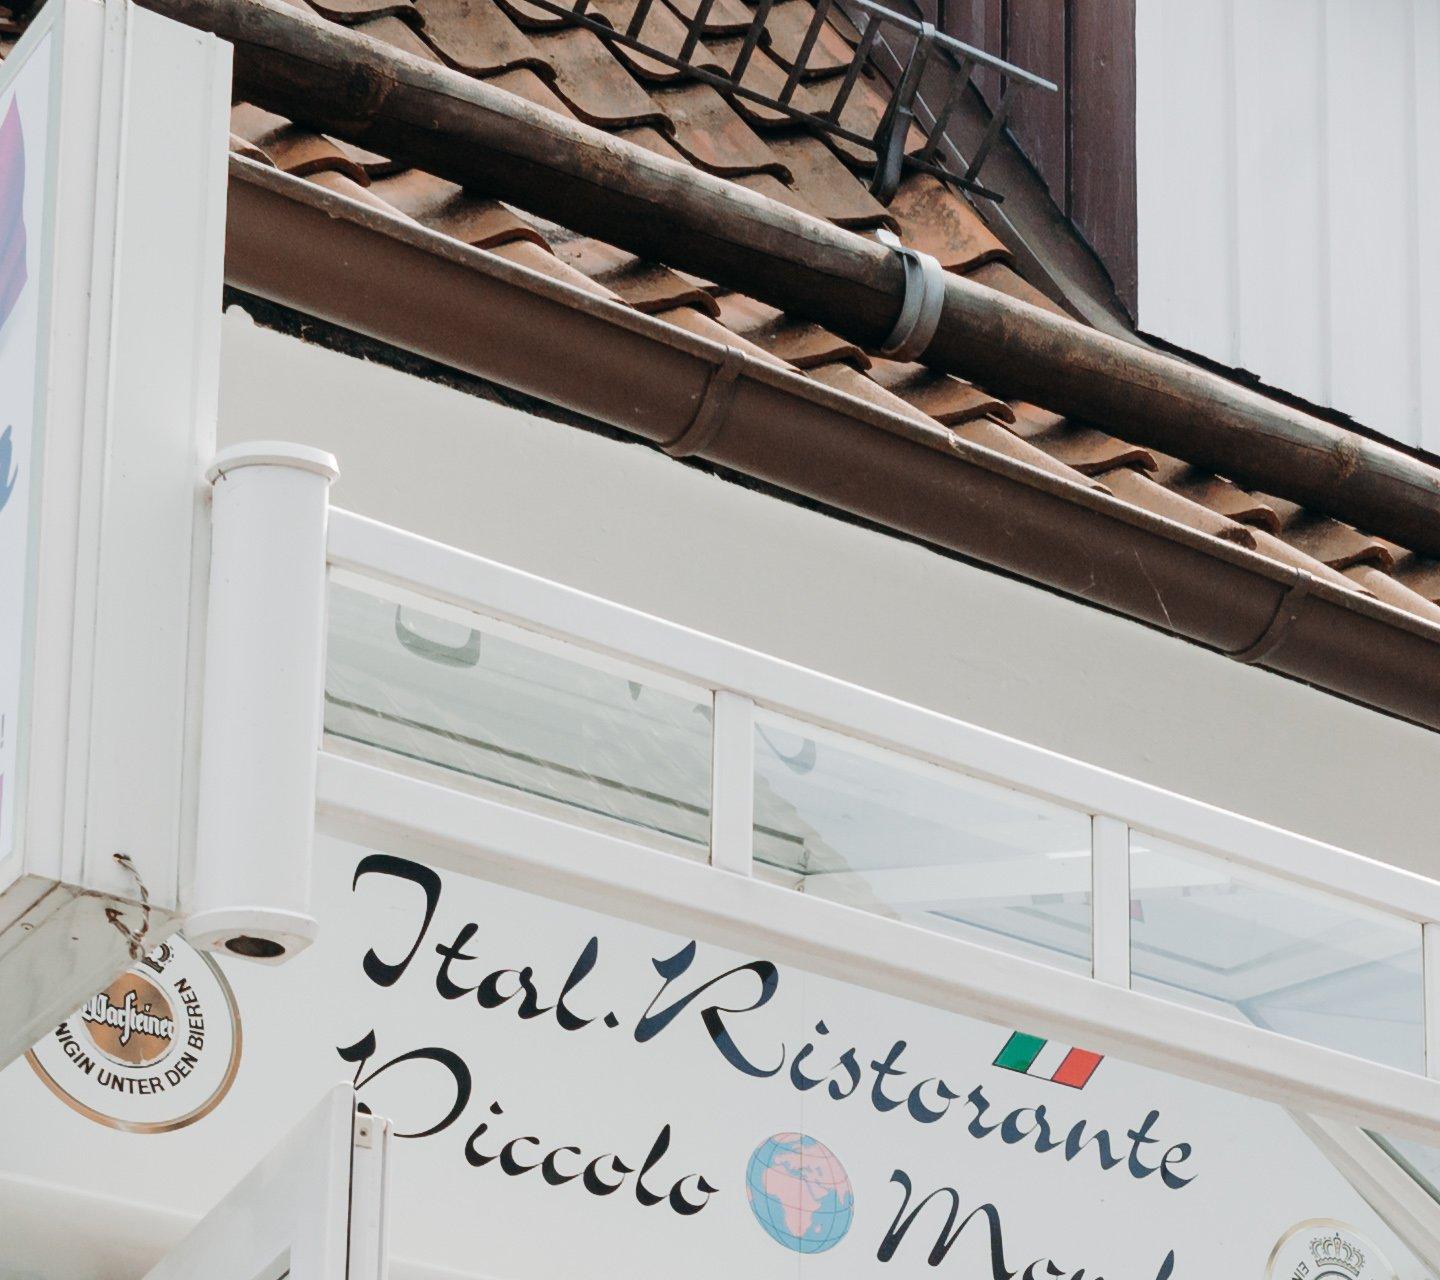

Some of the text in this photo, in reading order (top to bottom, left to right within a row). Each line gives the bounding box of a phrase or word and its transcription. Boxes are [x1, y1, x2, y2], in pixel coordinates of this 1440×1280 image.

[173, 977, 205, 1051] BIEREN
[97, 1068, 166, 1095] UNTER
[164, 1051, 199, 1087] DEN
[634, 939, 1200, 1191] Ristorante
[336, 1028, 720, 1217] Piccolo
